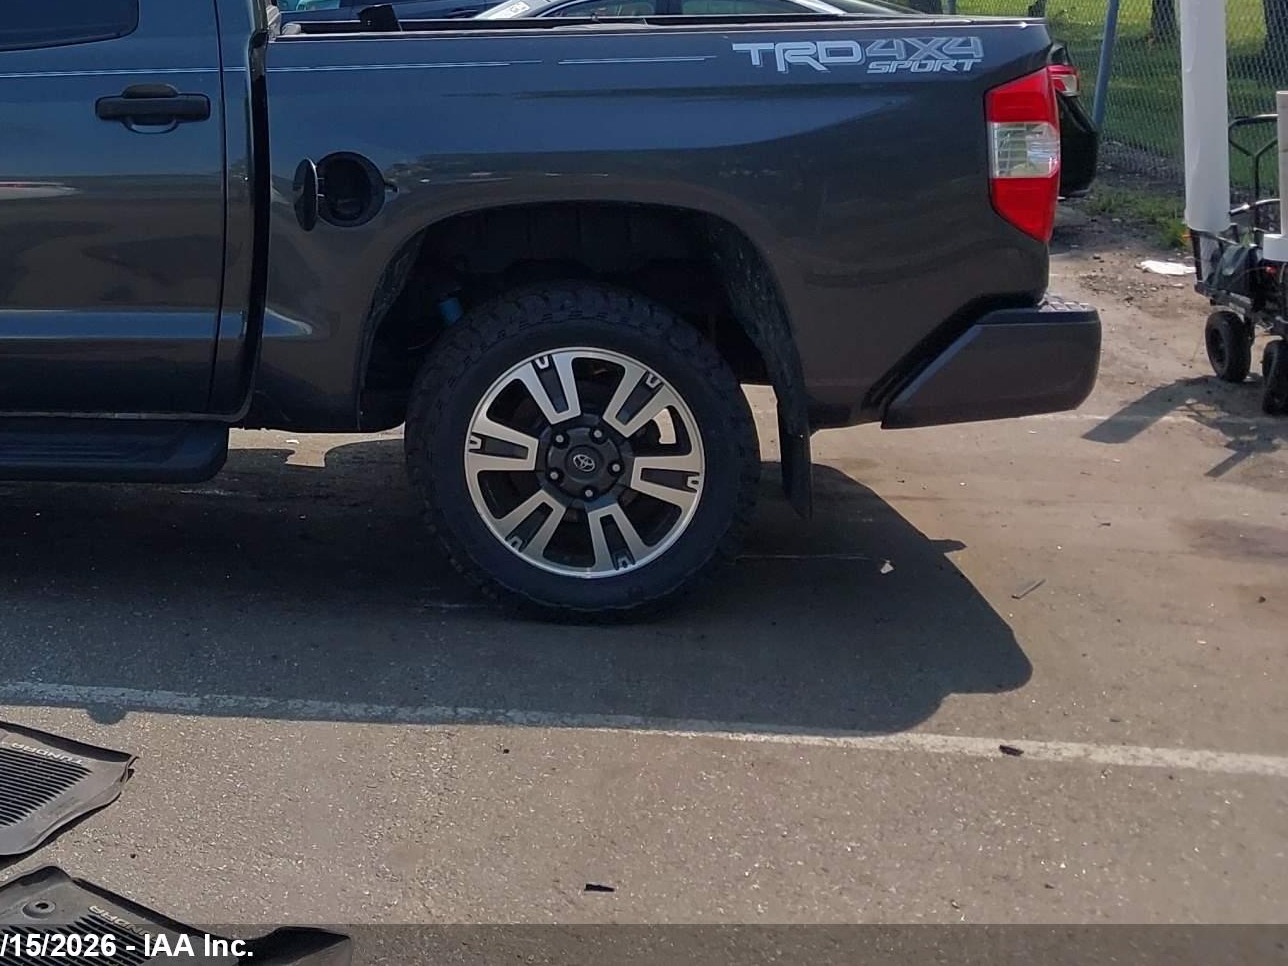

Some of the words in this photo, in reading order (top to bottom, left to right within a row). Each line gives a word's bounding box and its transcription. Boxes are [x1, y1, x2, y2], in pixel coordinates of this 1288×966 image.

[732, 41, 863, 72] TRD
[867, 58, 981, 73] SPORT
[12, 742, 82, 765] TUNDRA
